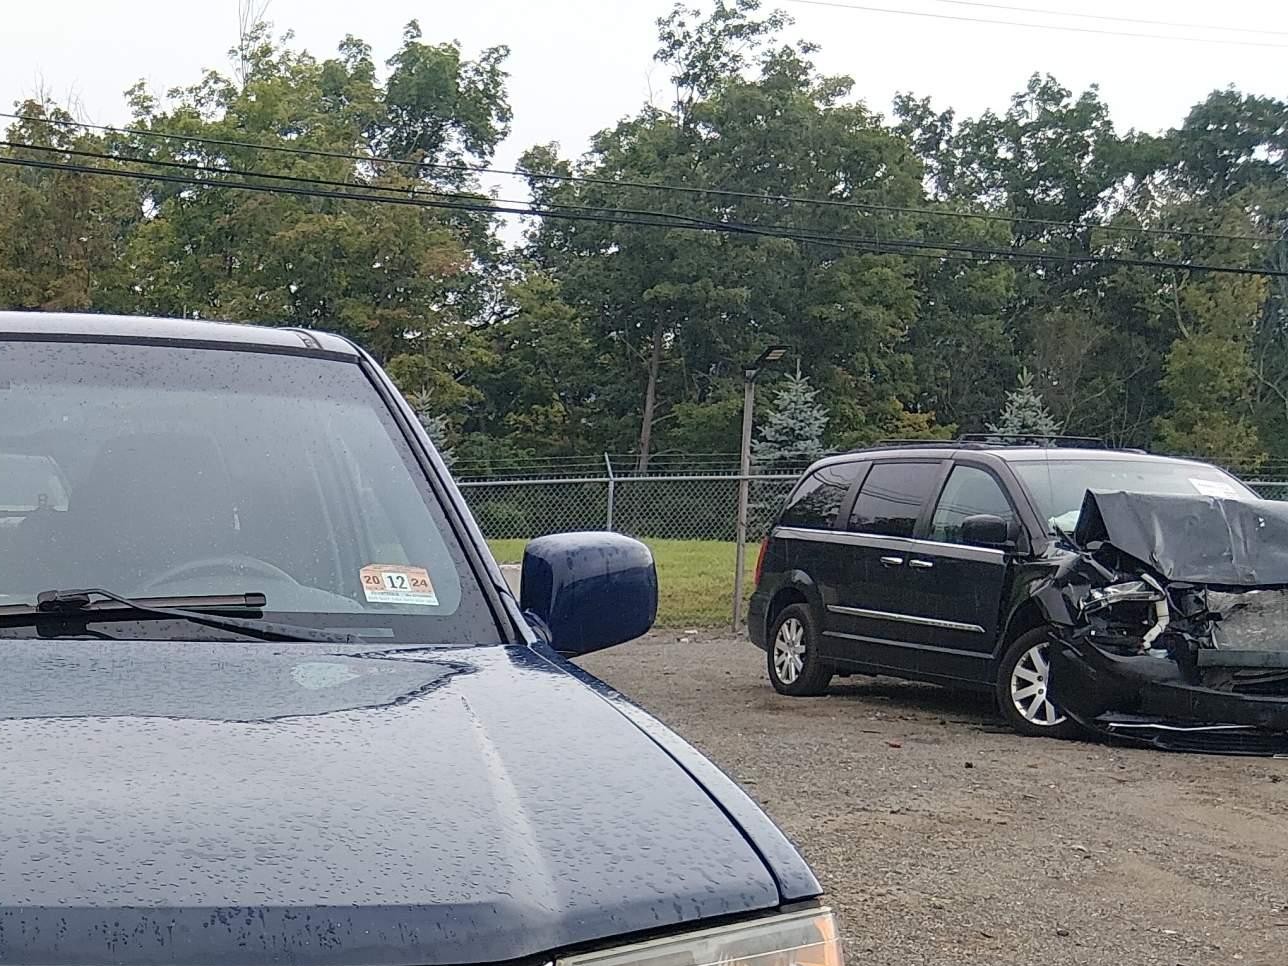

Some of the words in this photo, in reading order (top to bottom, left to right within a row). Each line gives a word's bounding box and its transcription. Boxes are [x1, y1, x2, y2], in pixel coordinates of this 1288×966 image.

[364, 575, 380, 584] 20
[387, 575, 408, 589] 12
[411, 578, 428, 587] 24
